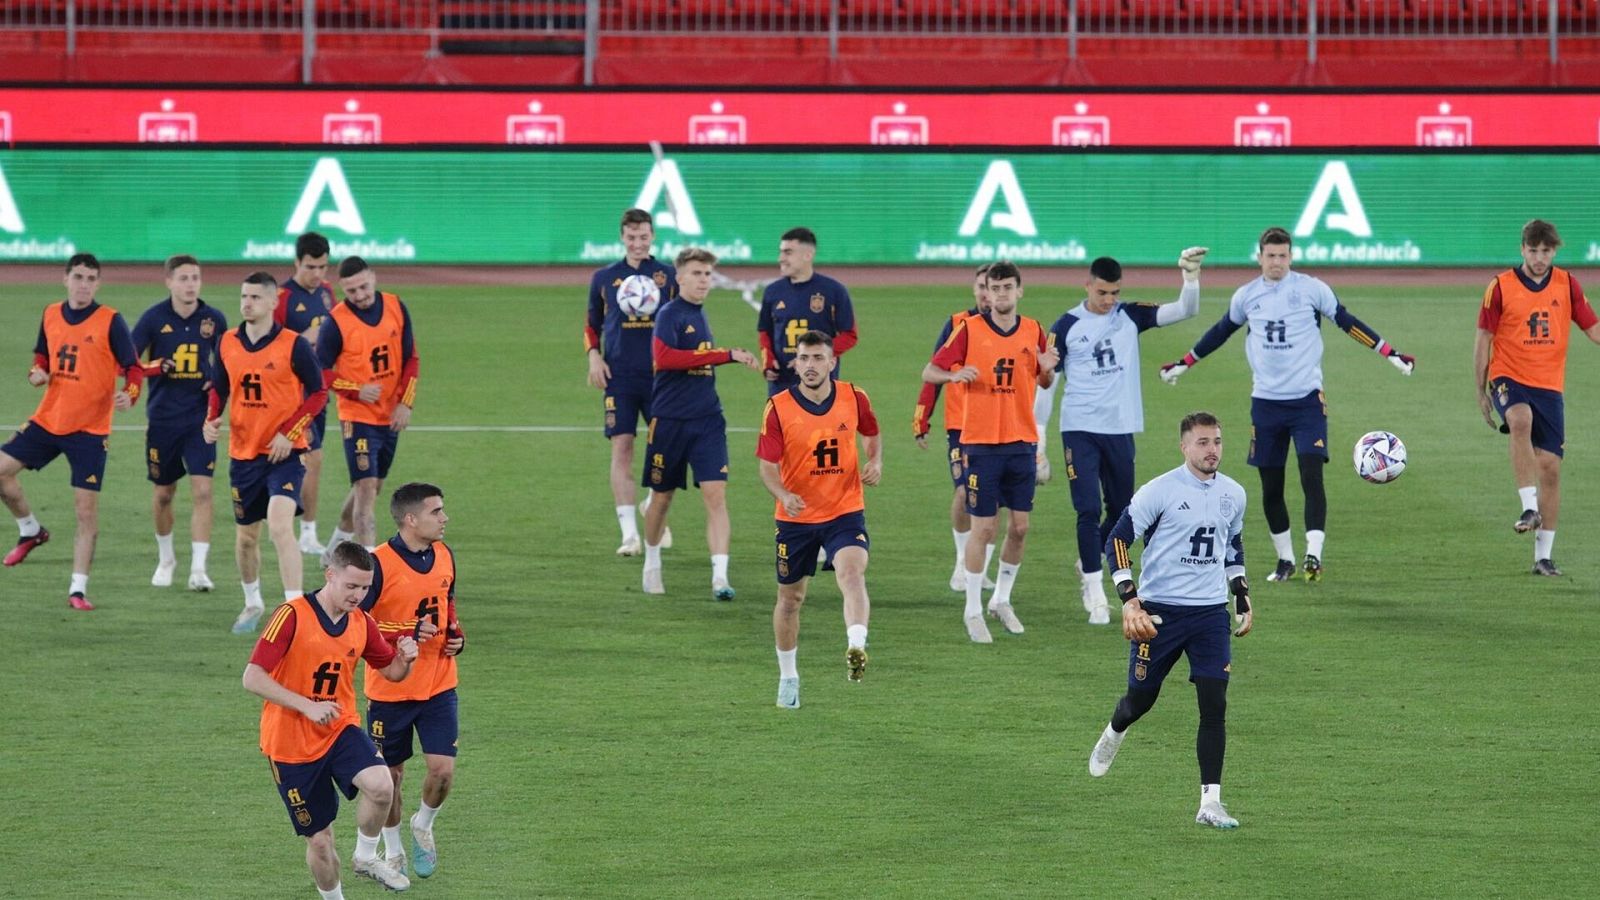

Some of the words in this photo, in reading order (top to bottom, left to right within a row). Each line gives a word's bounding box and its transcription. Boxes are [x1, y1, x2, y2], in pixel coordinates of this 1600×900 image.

[0, 238, 75, 258] ndalucía
[916, 241, 967, 260] Junta
[970, 241, 994, 260] de
[996, 239, 1086, 260] Andalucía
[1305, 242, 1328, 261] de
[1331, 240, 1421, 261] Andalucía
[1527, 311, 1549, 338] fi
[56, 344, 78, 373] fi
[172, 343, 198, 373] fi
[370, 344, 389, 374] fi
[1091, 338, 1117, 369] fi
[992, 357, 1015, 386] fi
[240, 373, 262, 401] fi
[812, 438, 839, 469] fi
[809, 467, 845, 476] network
[1189, 526, 1216, 558] fi
[1180, 556, 1218, 566] network
[312, 661, 342, 696] fi
